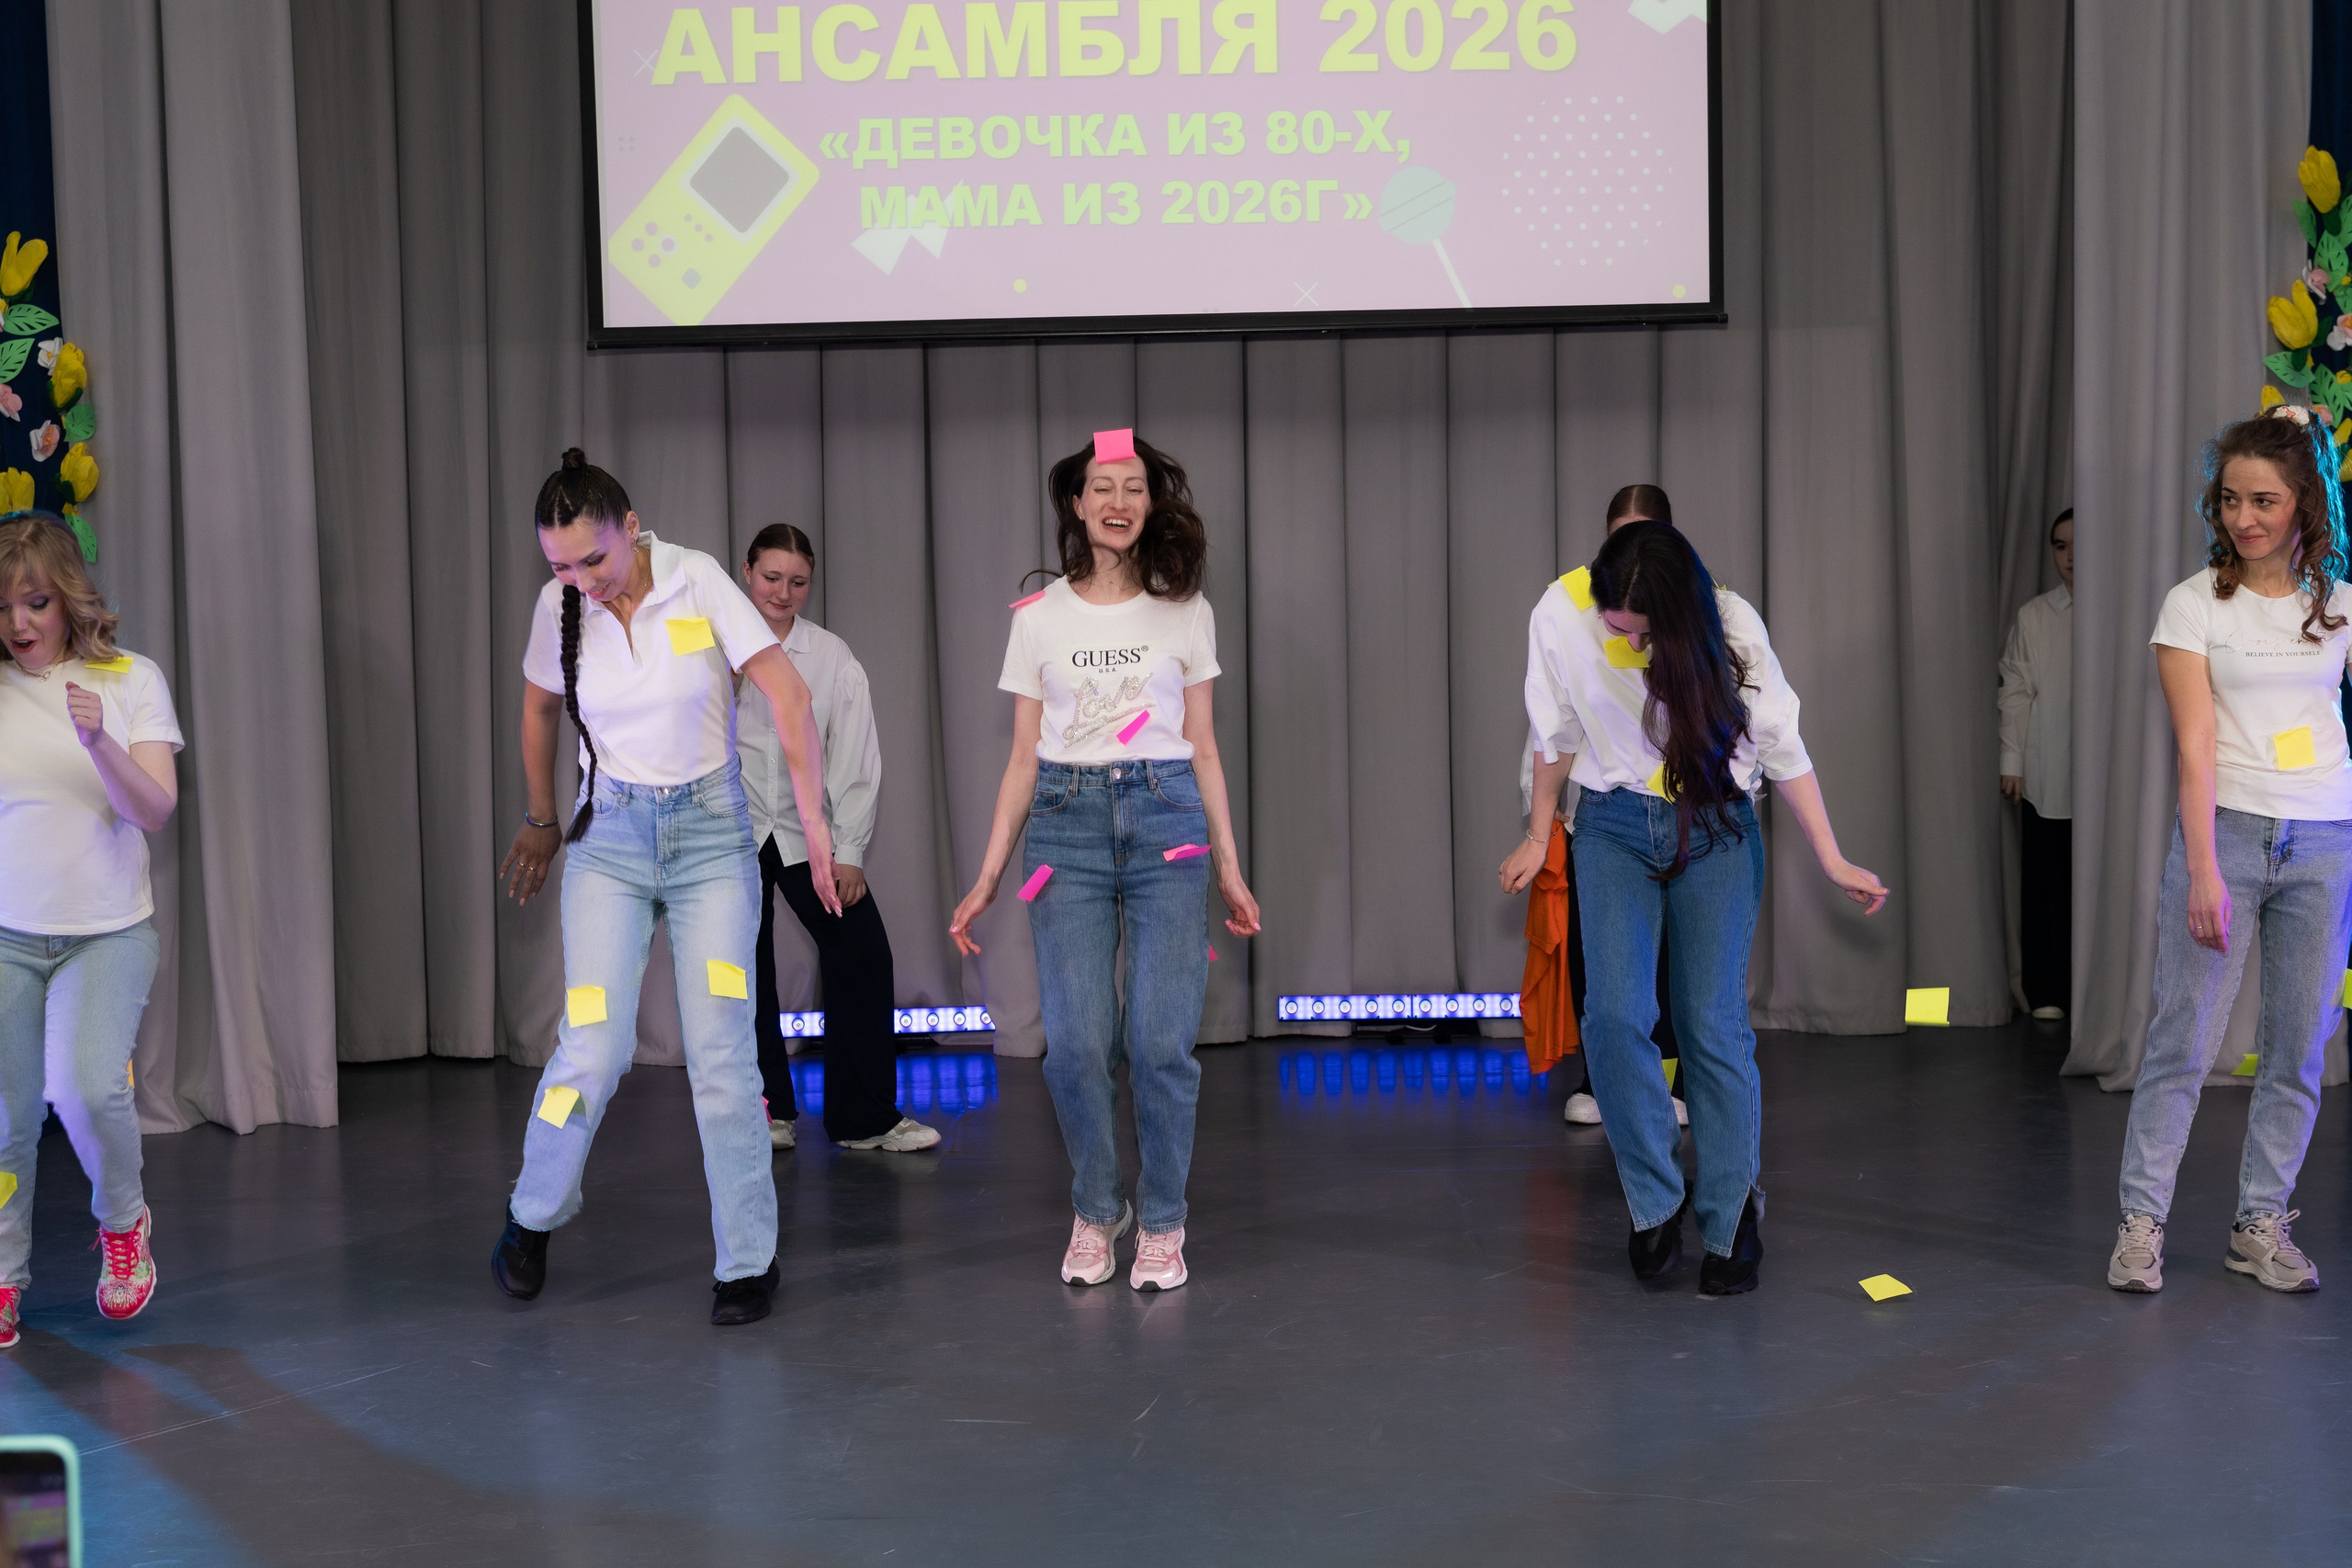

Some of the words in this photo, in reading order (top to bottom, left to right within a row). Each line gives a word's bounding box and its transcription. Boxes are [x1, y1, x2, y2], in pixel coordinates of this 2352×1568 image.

[650, 0, 1279, 85] АНСАМБЛЯ
[1318, 0, 1577, 73] 2026
[820, 113, 1148, 169] «ДЕВОЧКА
[1167, 111, 1246, 156] ИЗ
[1265, 109, 1410, 164] 80-Х,
[860, 184, 1043, 229] МАМА
[1063, 181, 1141, 226] ИЗ
[1160, 179, 1374, 224] 2026Г»
